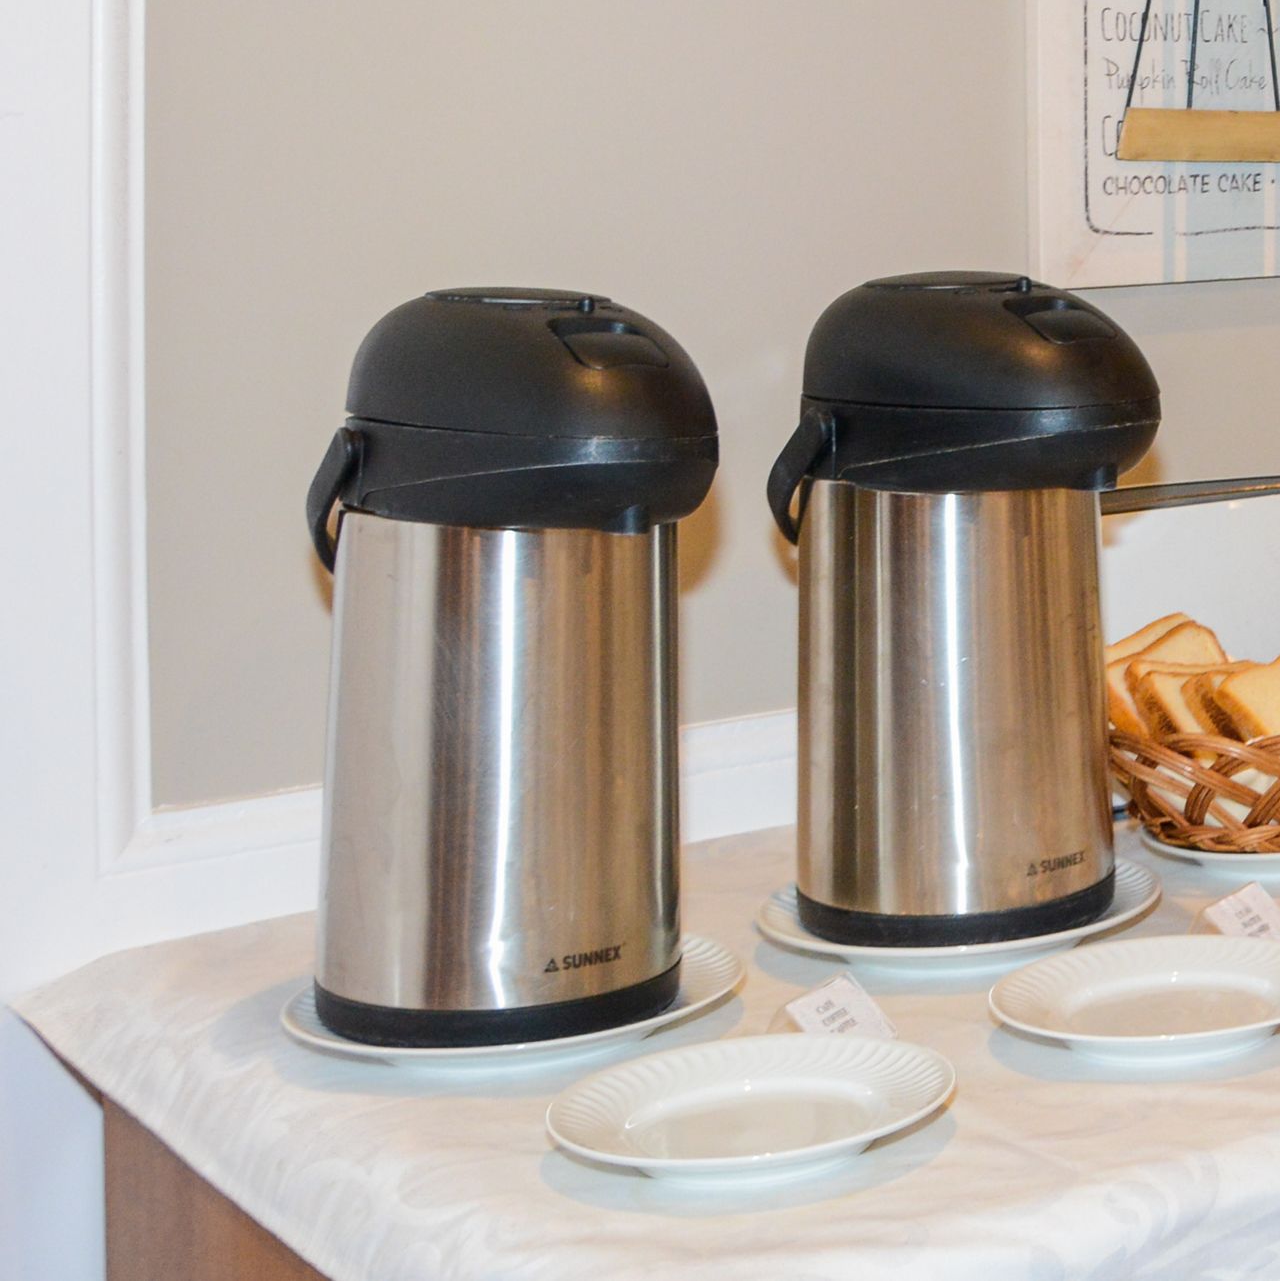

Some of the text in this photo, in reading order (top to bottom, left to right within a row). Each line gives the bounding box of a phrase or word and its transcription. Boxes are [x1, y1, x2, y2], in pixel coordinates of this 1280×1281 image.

[1200, 9, 1249, 44] CAKE
[1225, 59, 1269, 91] Cake
[1103, 174, 1211, 196] CHOCOLATE
[1217, 173, 1262, 193] CAKE
[1040, 850, 1086, 874] SUNNEX
[562, 945, 622, 971] SUNNEX
